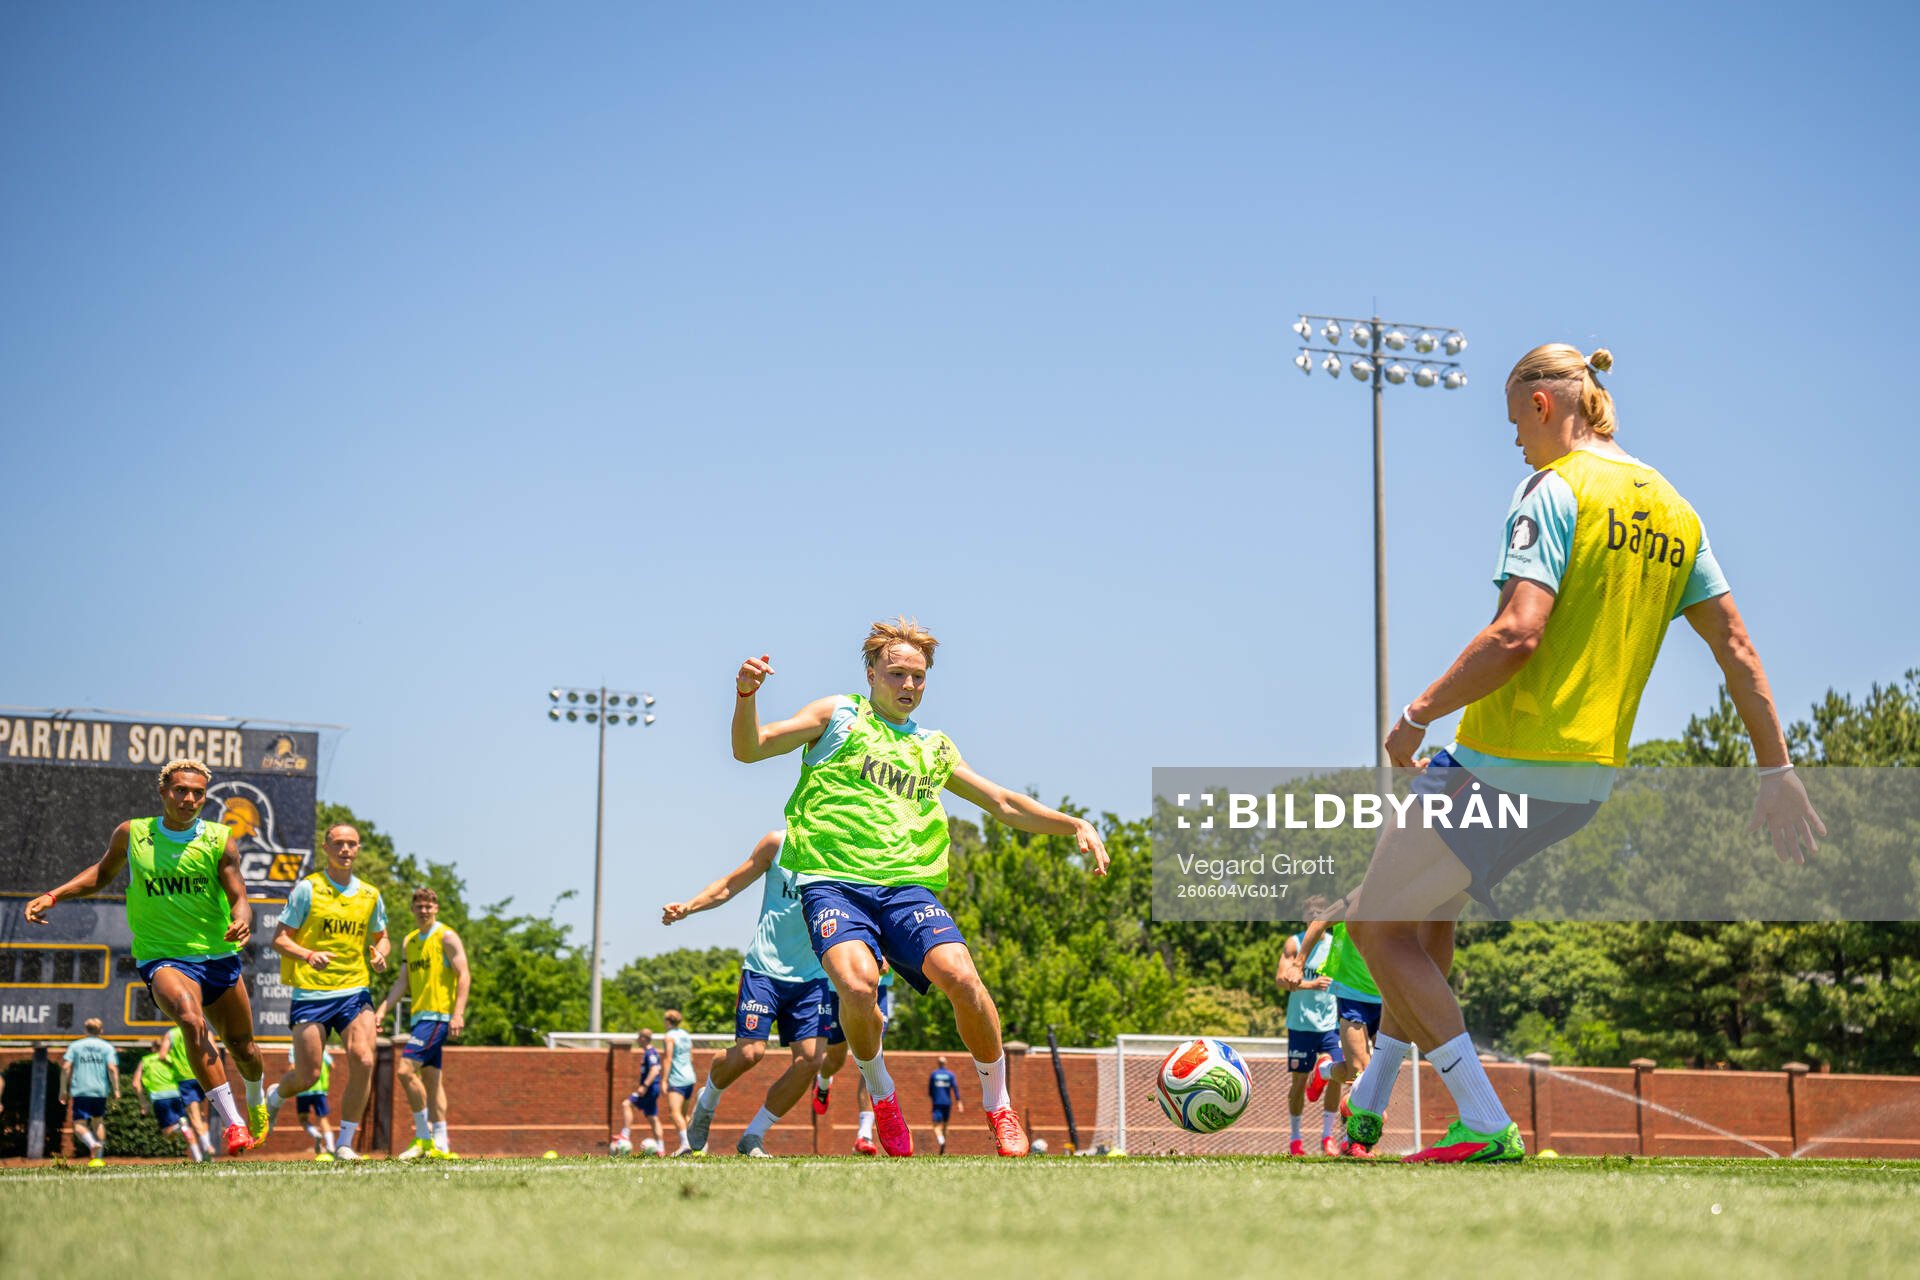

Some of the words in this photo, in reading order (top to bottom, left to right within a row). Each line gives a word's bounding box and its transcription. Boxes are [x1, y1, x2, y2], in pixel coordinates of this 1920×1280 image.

[0, 718, 112, 762] PARTAN
[127, 724, 243, 769] SOCCER
[860, 755, 917, 800] KIWI
[145, 876, 191, 897] KIWI
[323, 919, 356, 936] KIWI
[1, 1004, 50, 1023] HALF
